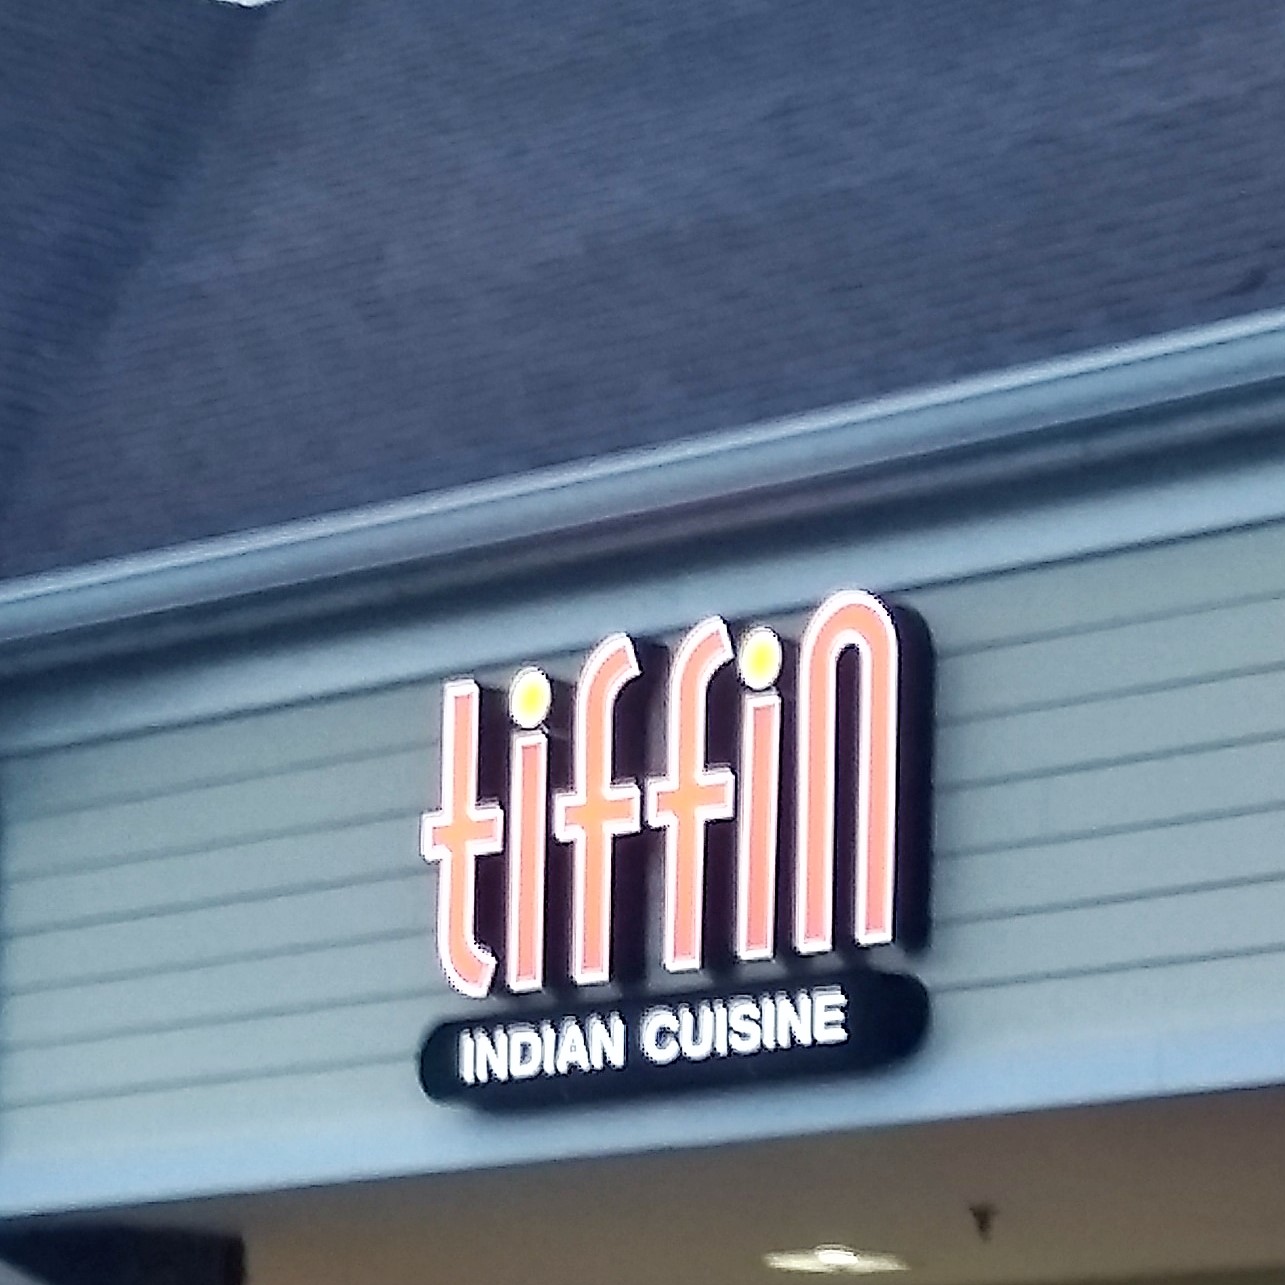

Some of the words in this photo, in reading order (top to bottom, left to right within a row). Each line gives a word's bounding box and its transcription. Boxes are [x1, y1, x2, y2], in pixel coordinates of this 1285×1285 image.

[420, 588, 899, 998] tiffin
[459, 1011, 626, 1086] INDIAN
[639, 985, 849, 1066] CUISINE
